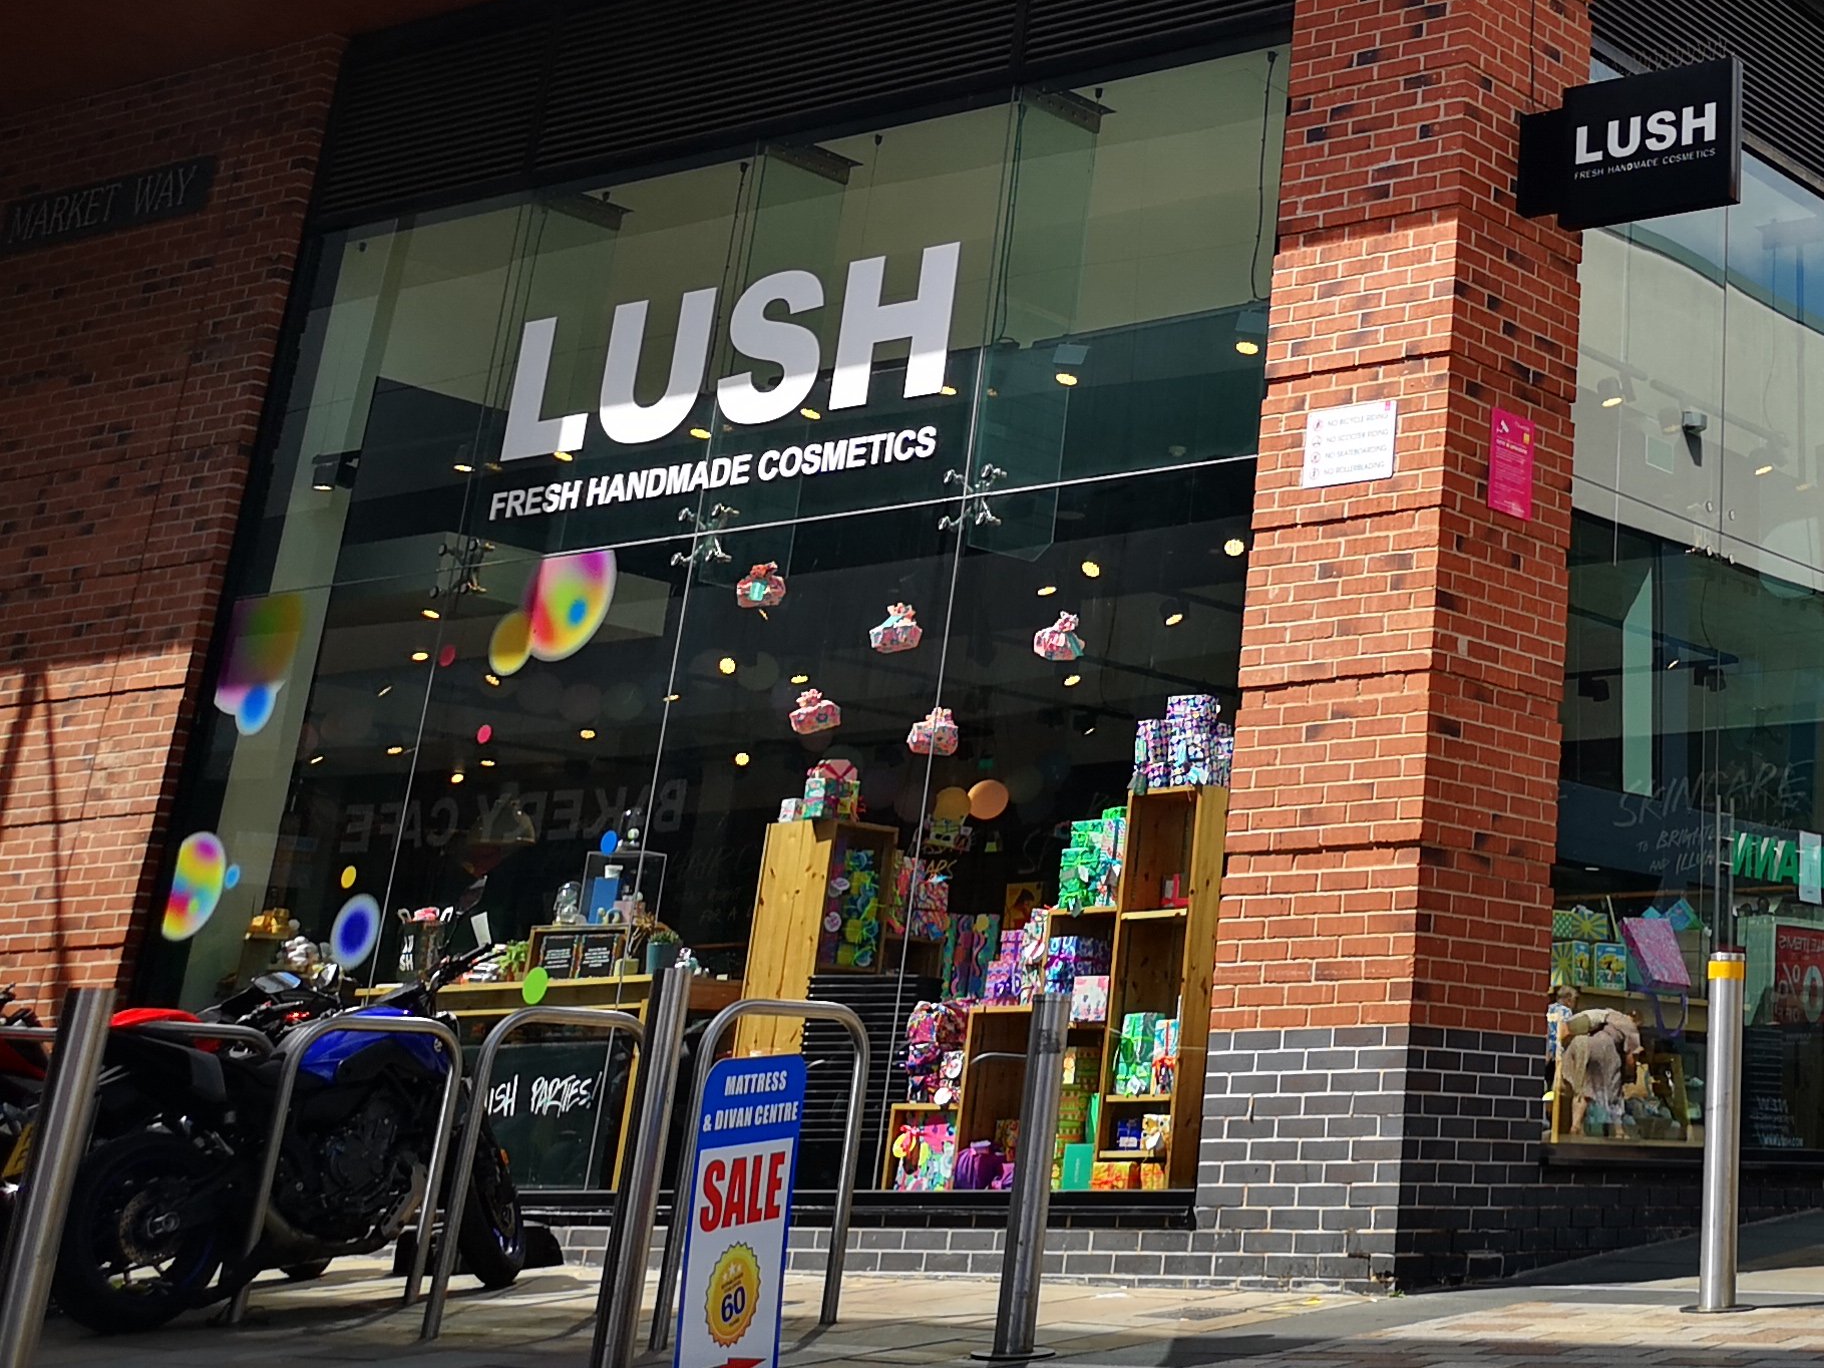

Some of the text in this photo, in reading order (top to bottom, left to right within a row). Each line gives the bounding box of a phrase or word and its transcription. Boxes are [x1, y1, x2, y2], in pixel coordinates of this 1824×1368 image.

[1574, 147, 1716, 181] FRESH HANDMADE COSMETICS
[1575, 101, 1717, 165] LUSH
[8, 165, 198, 243] MARKET WAY
[500, 241, 961, 461] LUSH
[488, 425, 937, 522] FRESH HANDMADE COSMETICS
[724, 1070, 788, 1097] MATTRESS
[702, 1101, 799, 1133] & DIVAN CENTRE
[699, 1150, 786, 1233] SALE
[721, 1286, 746, 1323] 60
